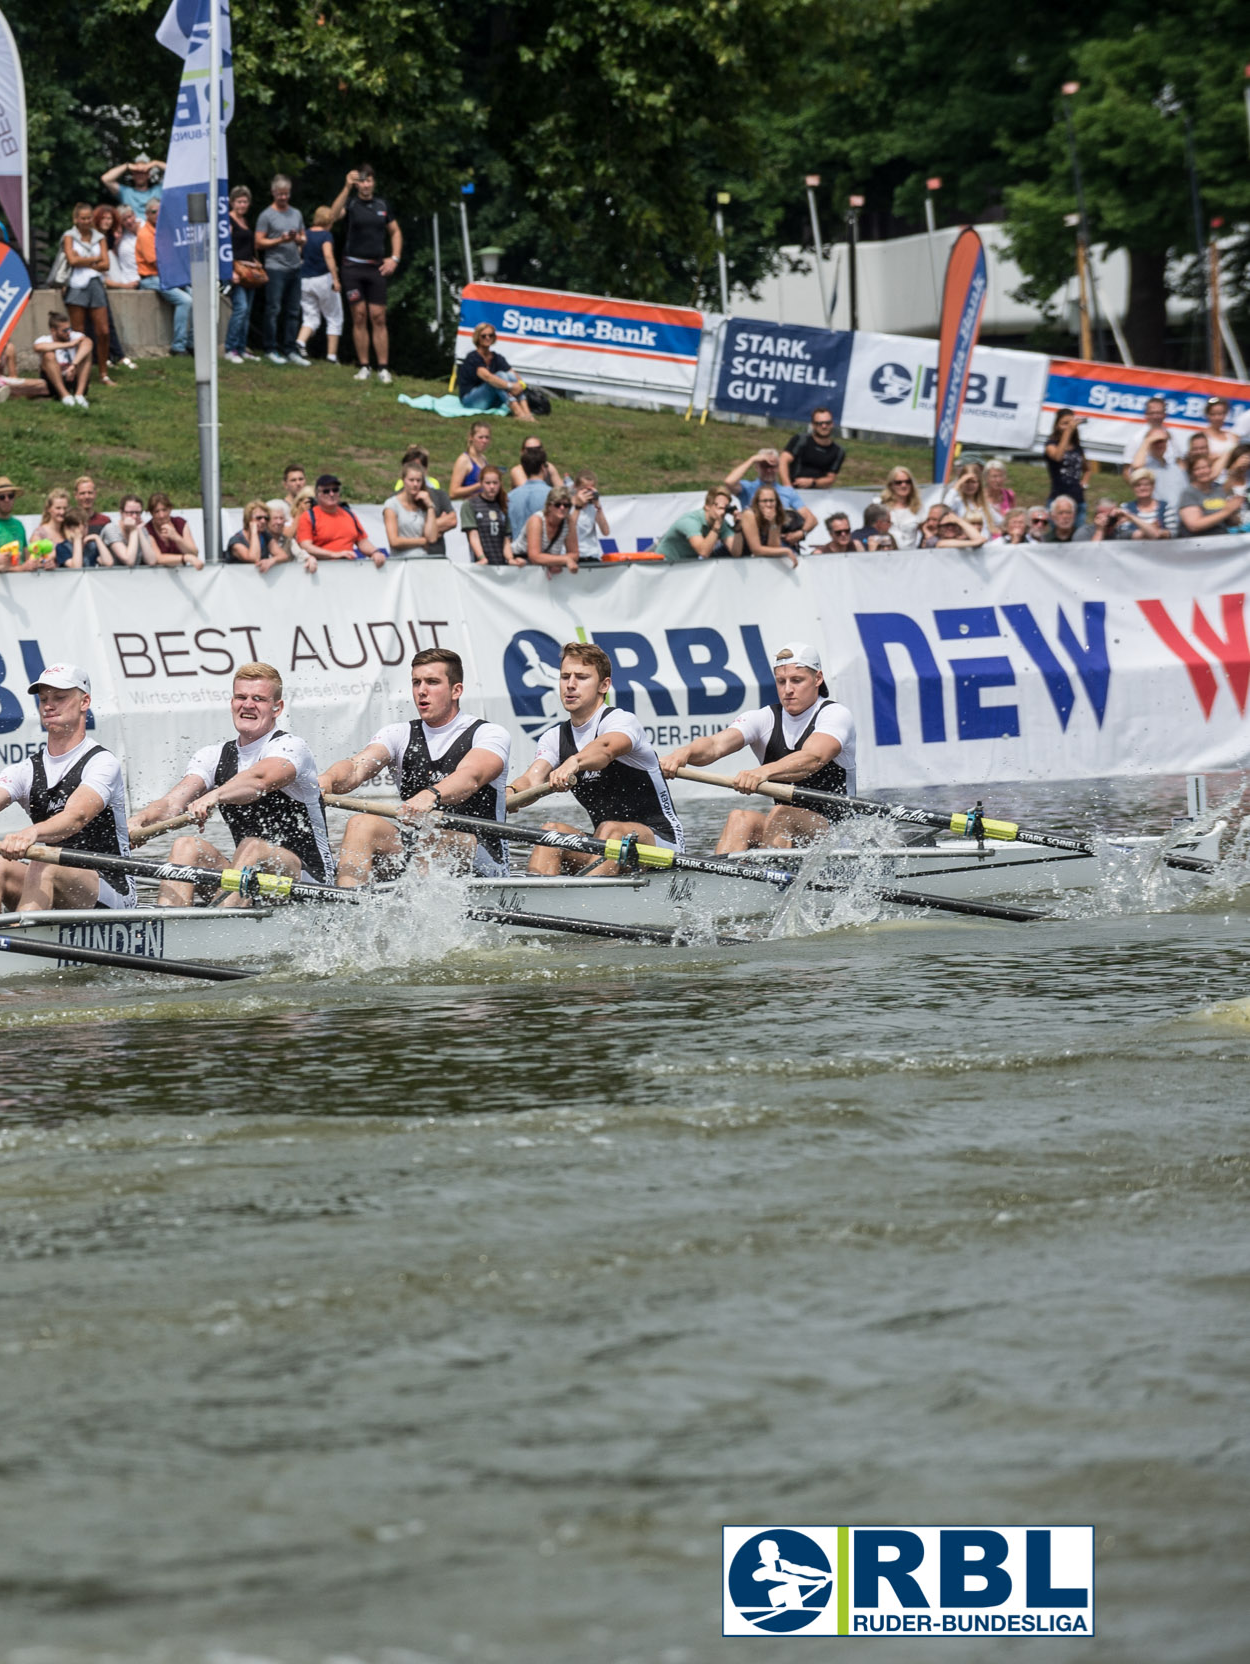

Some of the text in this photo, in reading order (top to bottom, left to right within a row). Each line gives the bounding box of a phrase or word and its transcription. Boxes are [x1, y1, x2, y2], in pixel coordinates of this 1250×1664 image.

[501, 308, 657, 347] Sparda-Bank
[734, 332, 812, 361] STARK.
[730, 357, 837, 388] SCHNELL.
[727, 380, 779, 405] GUT.
[113, 620, 449, 679] BEST AUDIT
[855, 601, 1112, 746] NEW
[675, 857, 789, 882] STARK. SCHNELL. GUT. RBL
